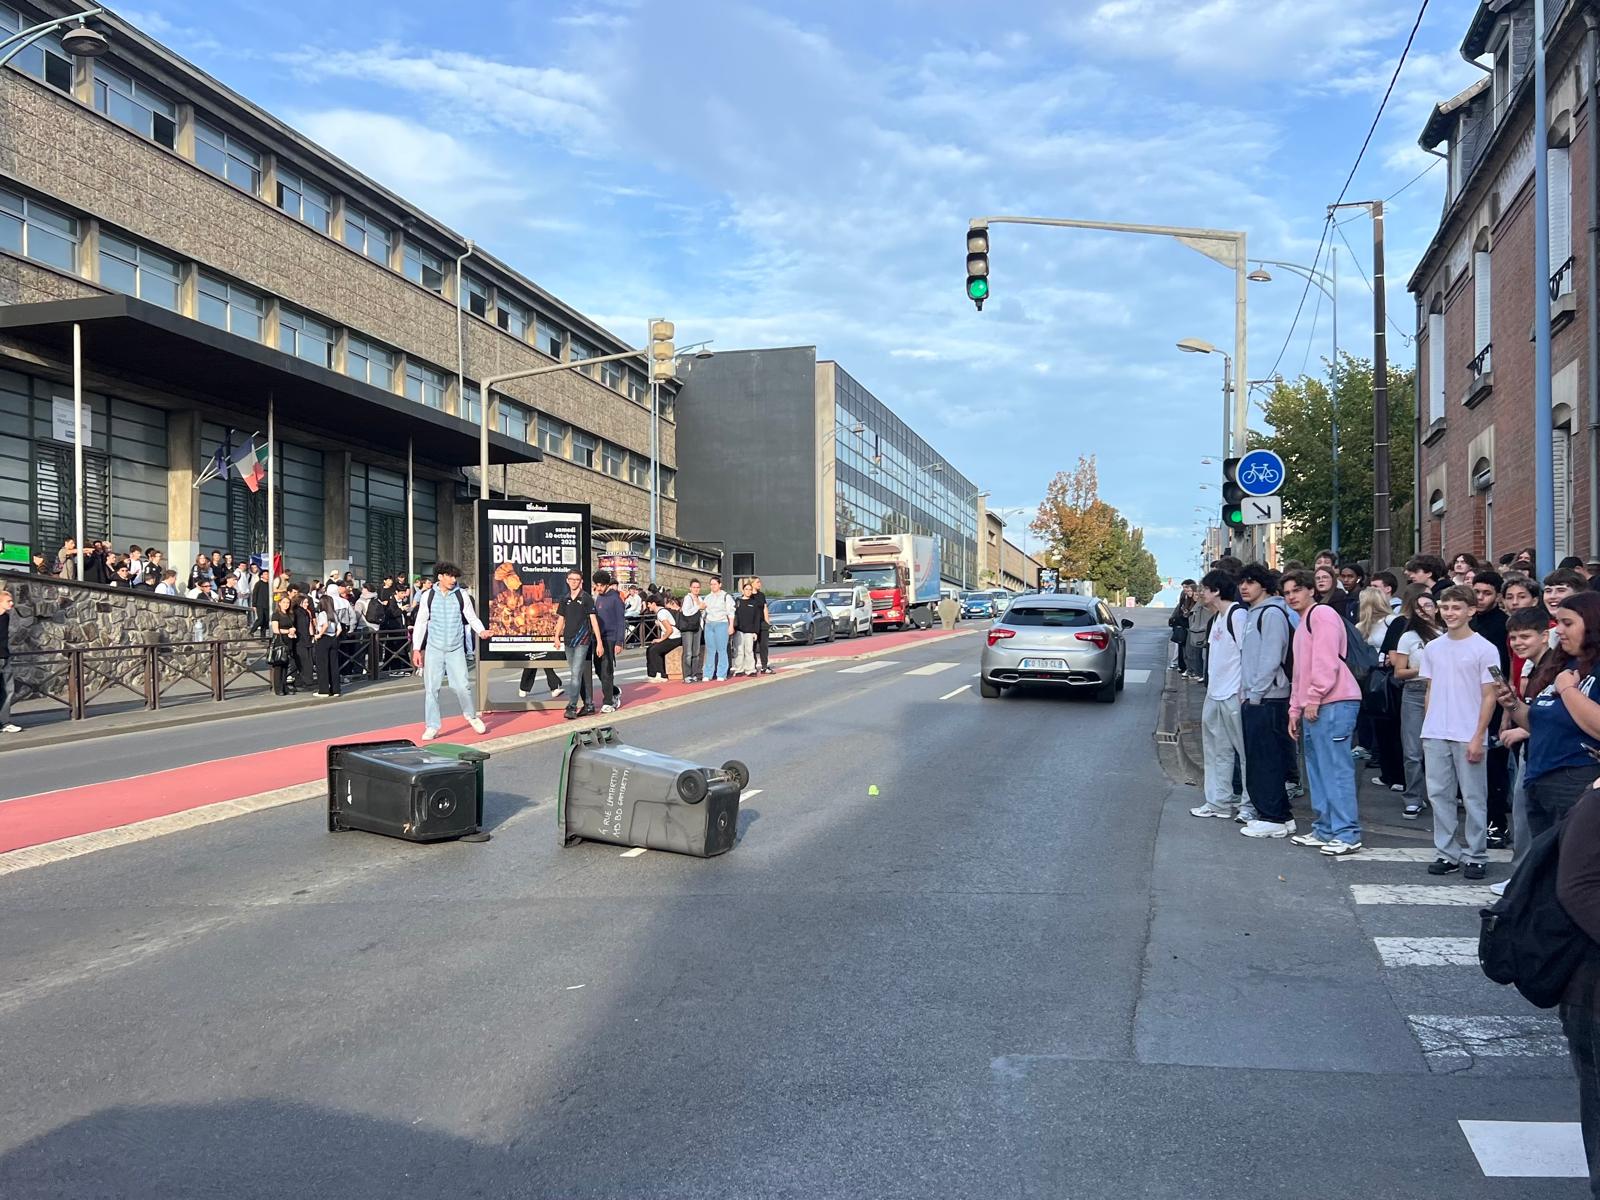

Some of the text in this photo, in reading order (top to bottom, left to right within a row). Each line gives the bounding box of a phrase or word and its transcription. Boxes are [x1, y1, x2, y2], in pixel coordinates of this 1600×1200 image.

[492, 524, 528, 544] NUIT
[492, 544, 562, 564] BLANCHE
[603, 810, 612, 826] RUE
[614, 808, 623, 821] BD
